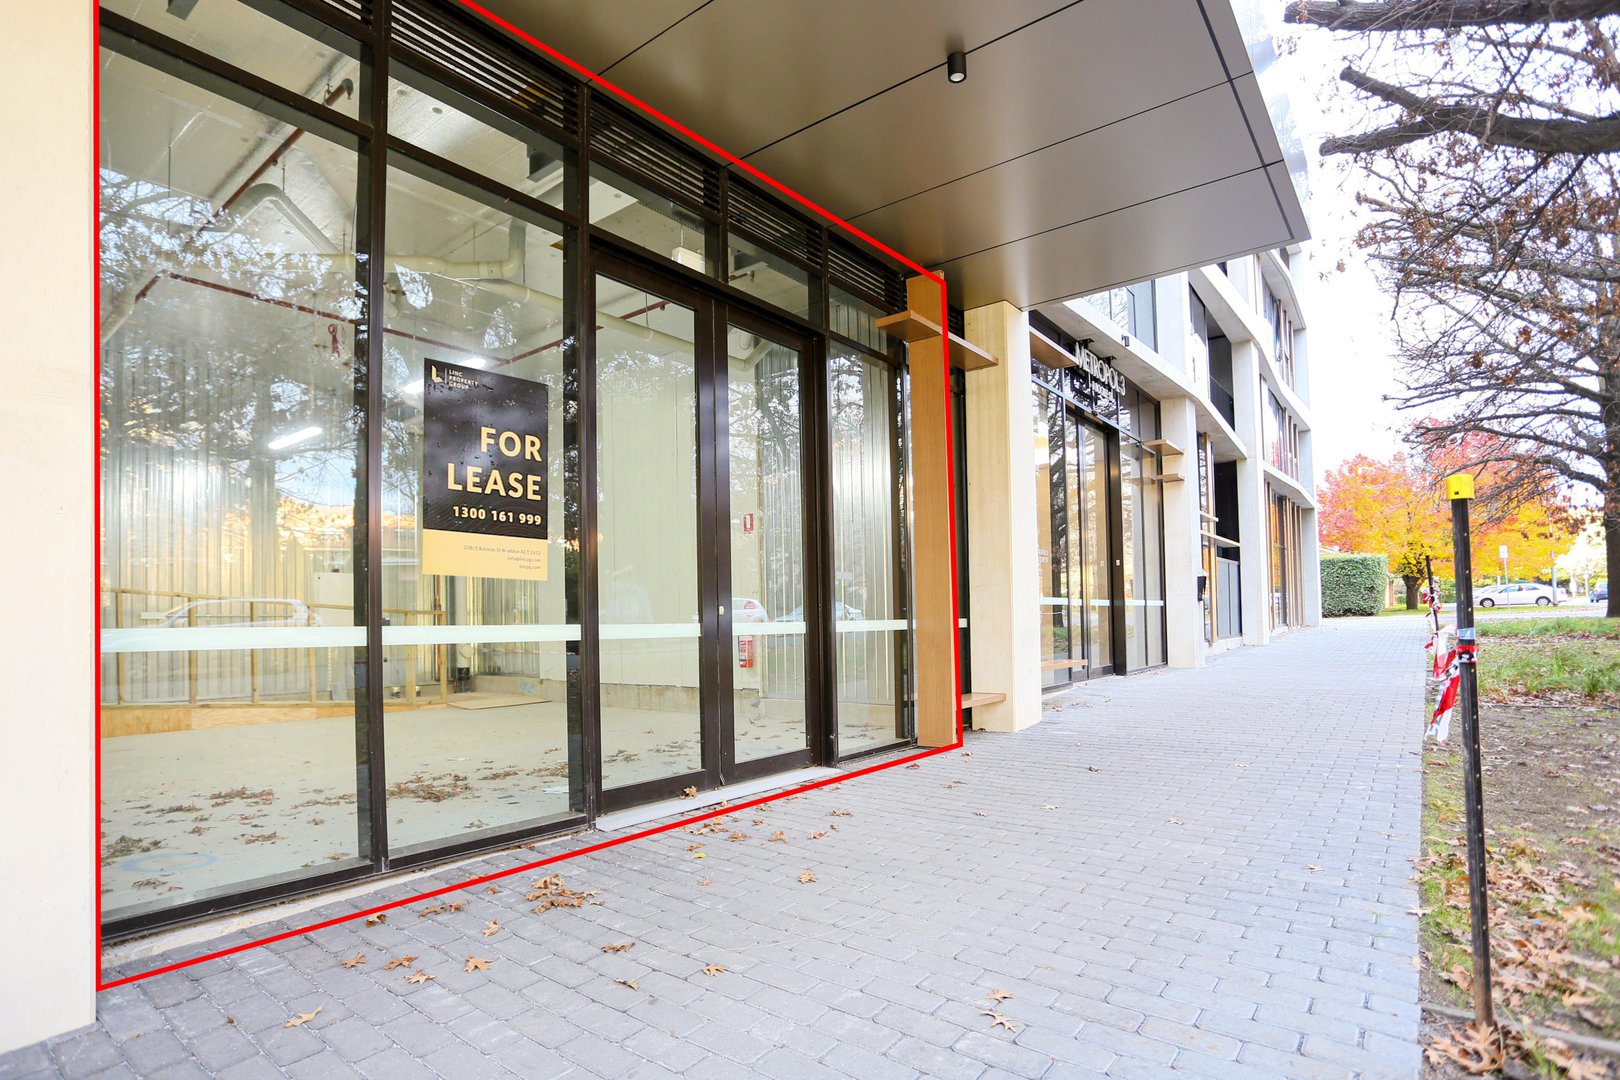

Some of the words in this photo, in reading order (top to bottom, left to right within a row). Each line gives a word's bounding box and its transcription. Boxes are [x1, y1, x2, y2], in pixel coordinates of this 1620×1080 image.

[448, 369, 463, 377] LINC
[448, 375, 479, 386] PROPERTY
[448, 381, 469, 389] GROUP
[480, 426, 542, 462] FOR
[447, 462, 542, 500] LEASE
[453, 506, 486, 519] 1300
[491, 510, 513, 523] 161
[518, 513, 542, 525] 999
